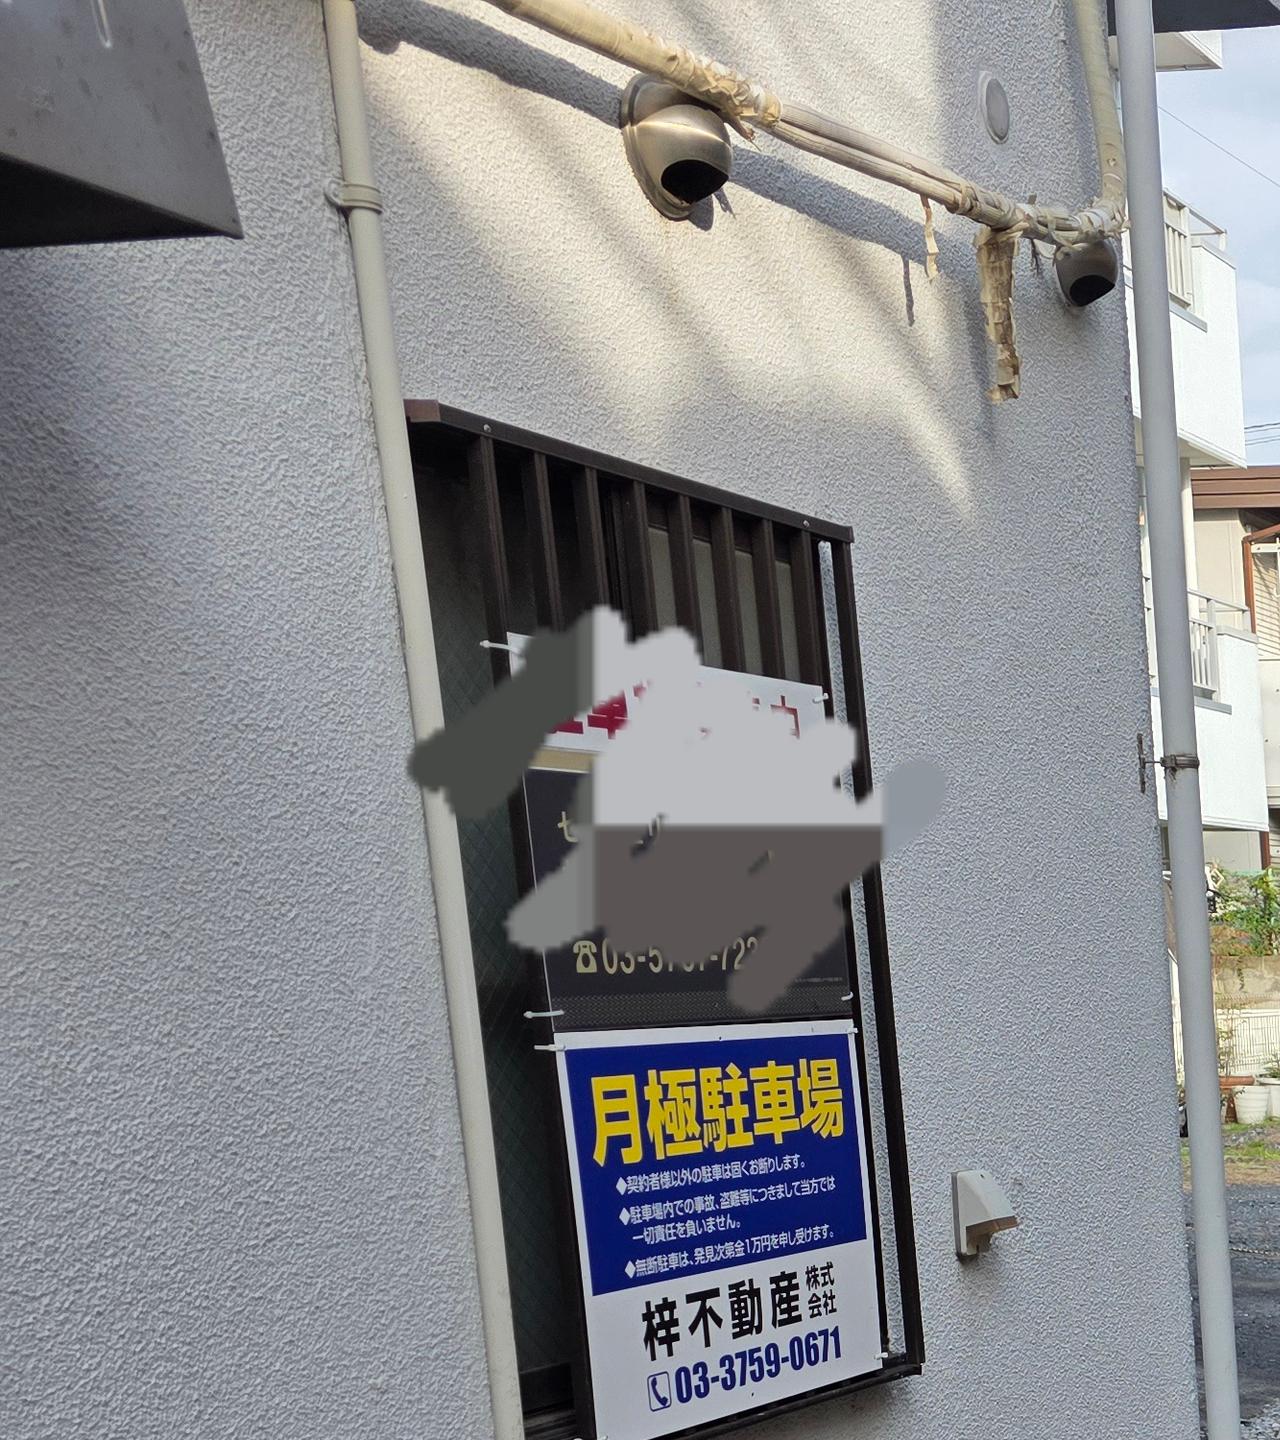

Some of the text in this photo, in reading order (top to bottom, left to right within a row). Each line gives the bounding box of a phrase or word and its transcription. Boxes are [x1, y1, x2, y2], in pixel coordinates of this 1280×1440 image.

[591, 1058, 844, 1168] 月極駐車場
[632, 1213, 742, 1246] 一切責任を負いません。
[804, 1261, 836, 1292] 株式
[807, 1289, 838, 1318] 会社
[641, 1270, 803, 1362] 梓不動産
[674, 1325, 843, 1404] 03-3759-0671
